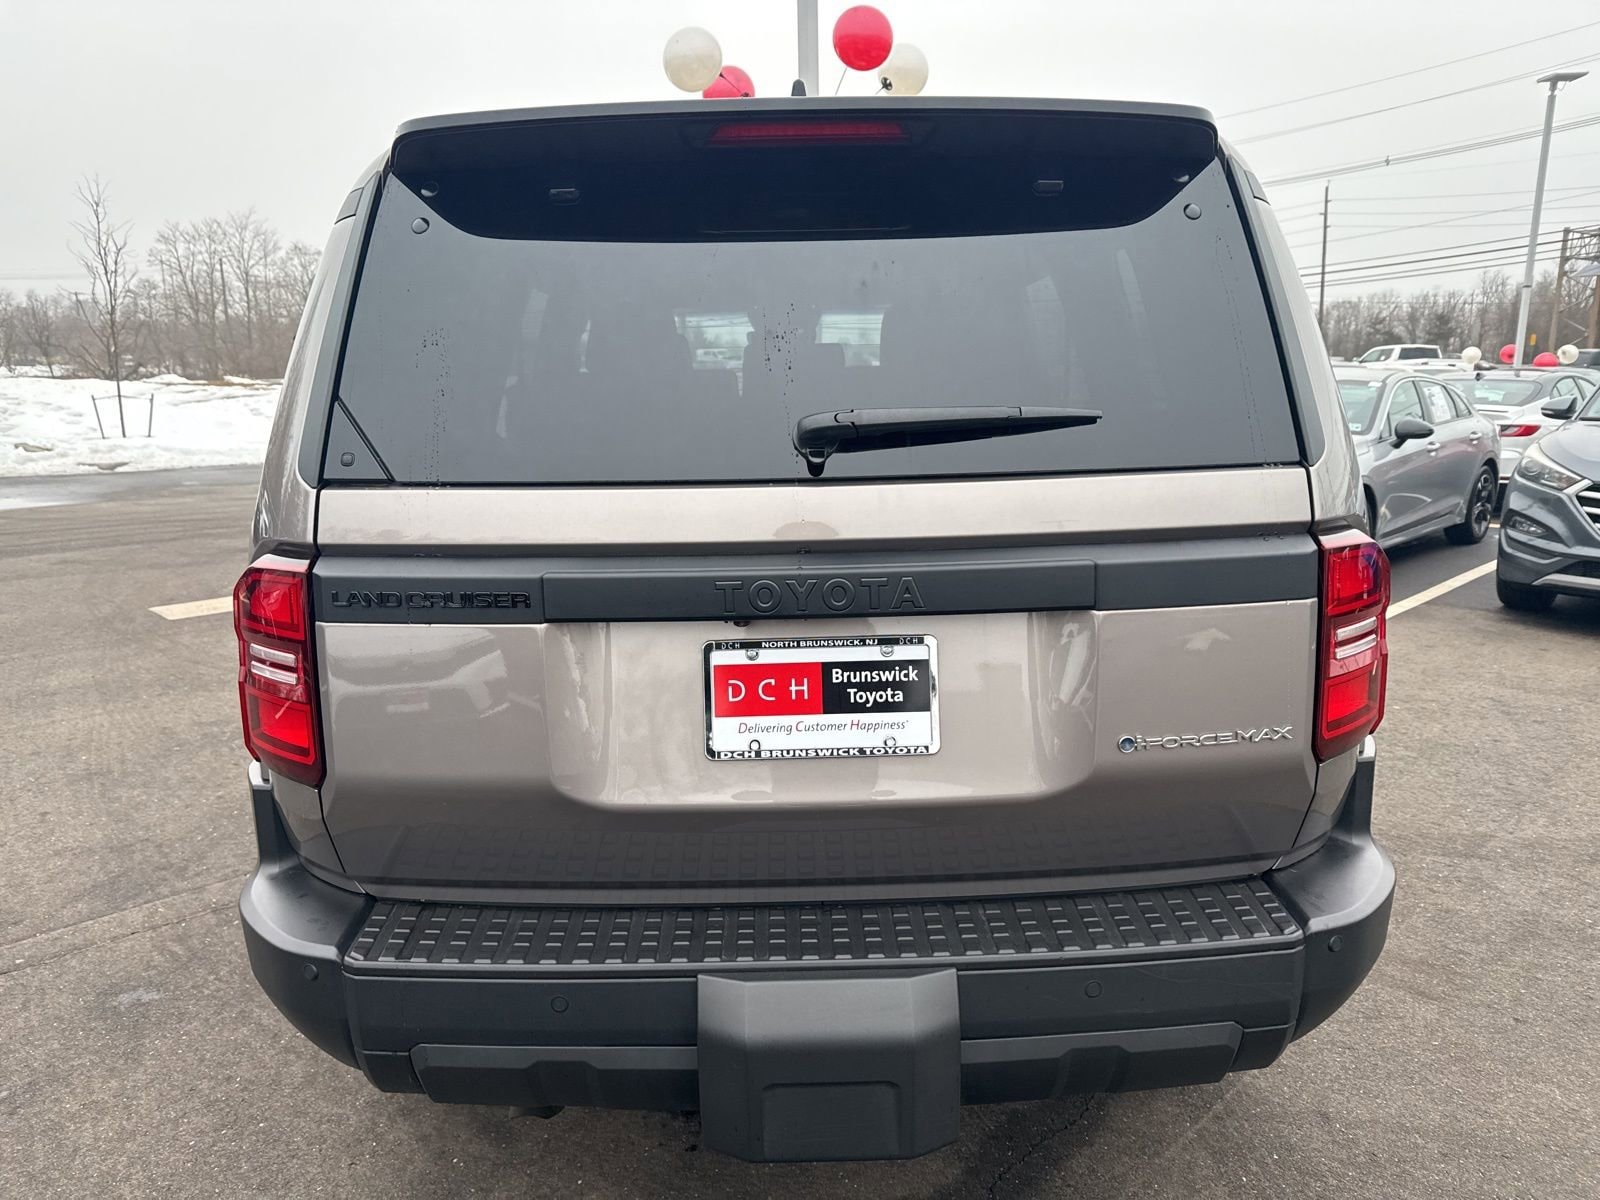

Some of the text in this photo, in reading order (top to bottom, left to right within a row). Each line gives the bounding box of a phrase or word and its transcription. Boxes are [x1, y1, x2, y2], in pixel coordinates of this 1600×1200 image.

[331, 590, 532, 609] LAND CRUISER
[714, 577, 927, 614] TOYOTA
[721, 642, 741, 650] DCH
[761, 638, 879, 649] NORTH BRUNSWICK, NJ
[899, 636, 919, 645] DCH
[831, 665, 919, 684] Brunswick
[727, 677, 809, 702] DCH
[846, 687, 904, 708] Toyota
[738, 718, 906, 736] Delivering Customer Happiness
[720, 745, 928, 760] DCH BRUNSWICK TOYOTA
